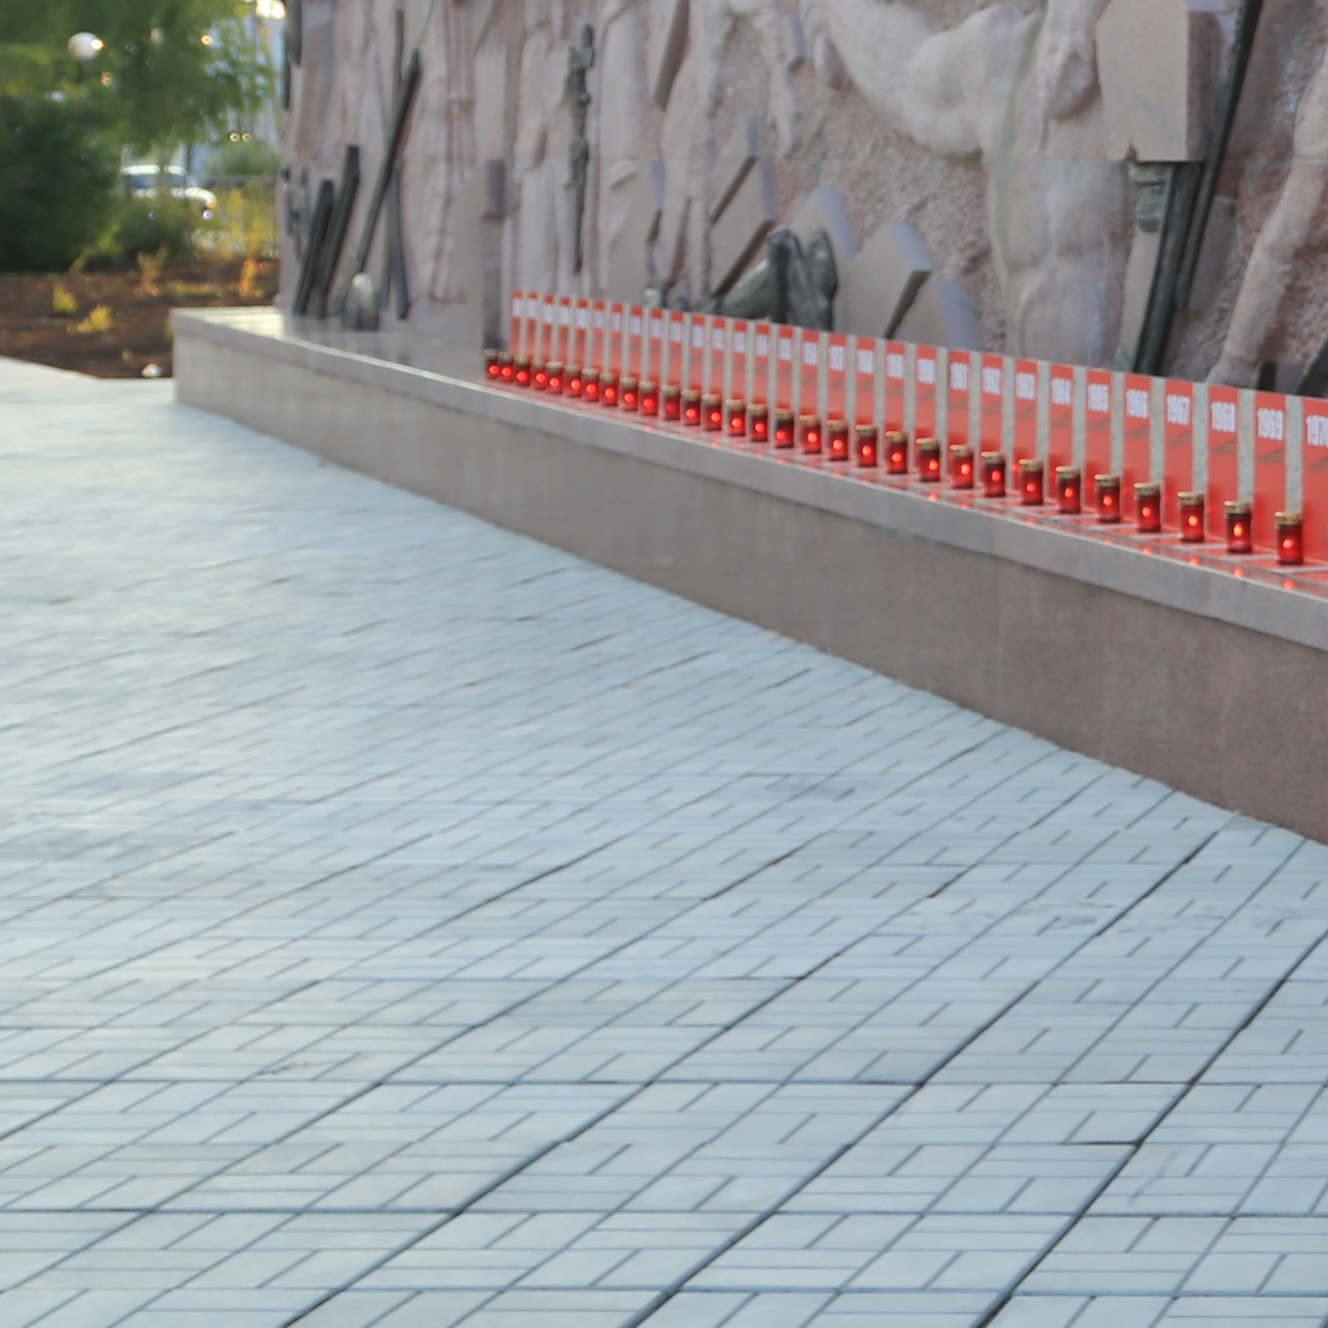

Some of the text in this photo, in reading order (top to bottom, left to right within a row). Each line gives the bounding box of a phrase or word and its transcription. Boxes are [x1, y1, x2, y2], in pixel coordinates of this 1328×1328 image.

[1087, 384, 1110, 412] 1965
[1126, 390, 1149, 419] 1966
[1165, 394, 1191, 425] 1967
[1210, 401, 1237, 433] 1968
[1257, 407, 1284, 441] 1969
